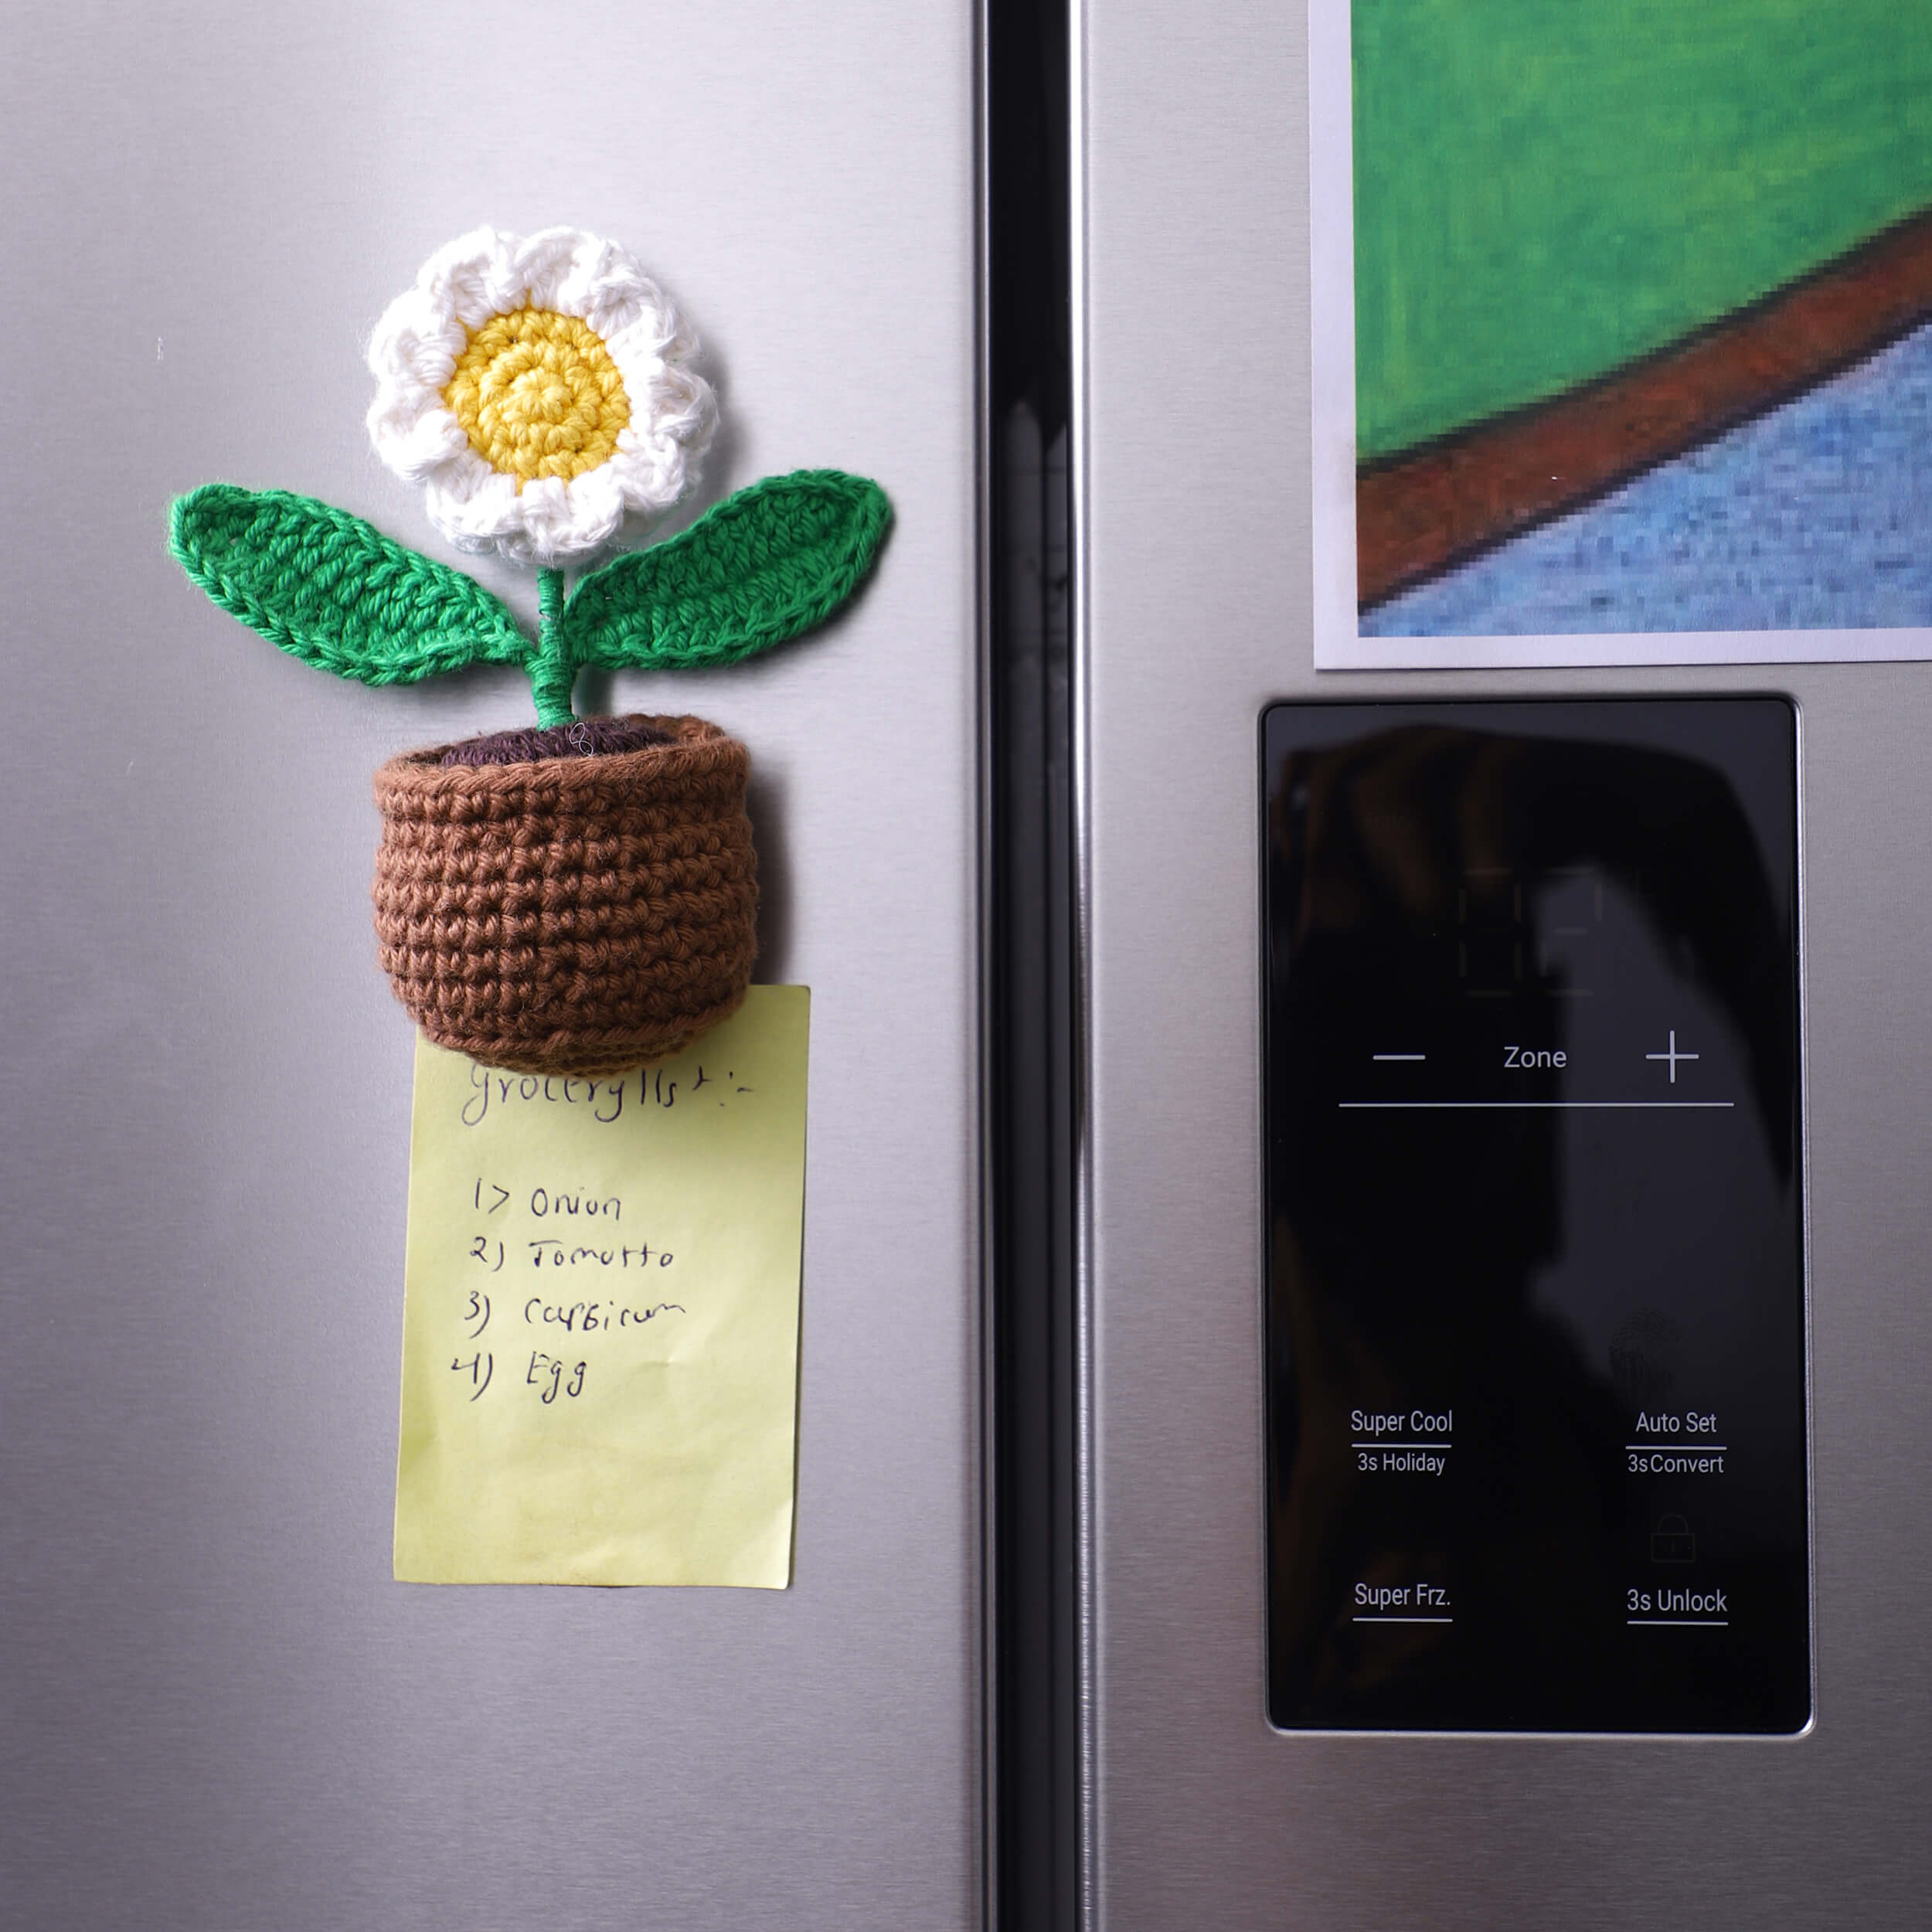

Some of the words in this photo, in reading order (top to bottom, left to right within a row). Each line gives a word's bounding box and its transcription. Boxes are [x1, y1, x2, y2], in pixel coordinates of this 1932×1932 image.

[1503, 1046, 1568, 1069] Zone
[531, 1186, 621, 1221] Onion
[526, 1350, 587, 1404] Egg
[1350, 1410, 1406, 1437] Super
[1410, 1410, 1453, 1433] Cool
[1634, 1411, 1681, 1434] Auto
[1685, 1411, 1718, 1434] Set
[1357, 1452, 1379, 1472] 3s
[1383, 1452, 1446, 1477] Holiday
[1354, 1582, 1411, 1611] Super
[1416, 1583, 1451, 1607] Frz.
[1627, 1588, 1652, 1611] 3s
[1657, 1588, 1728, 1612] Unlock
